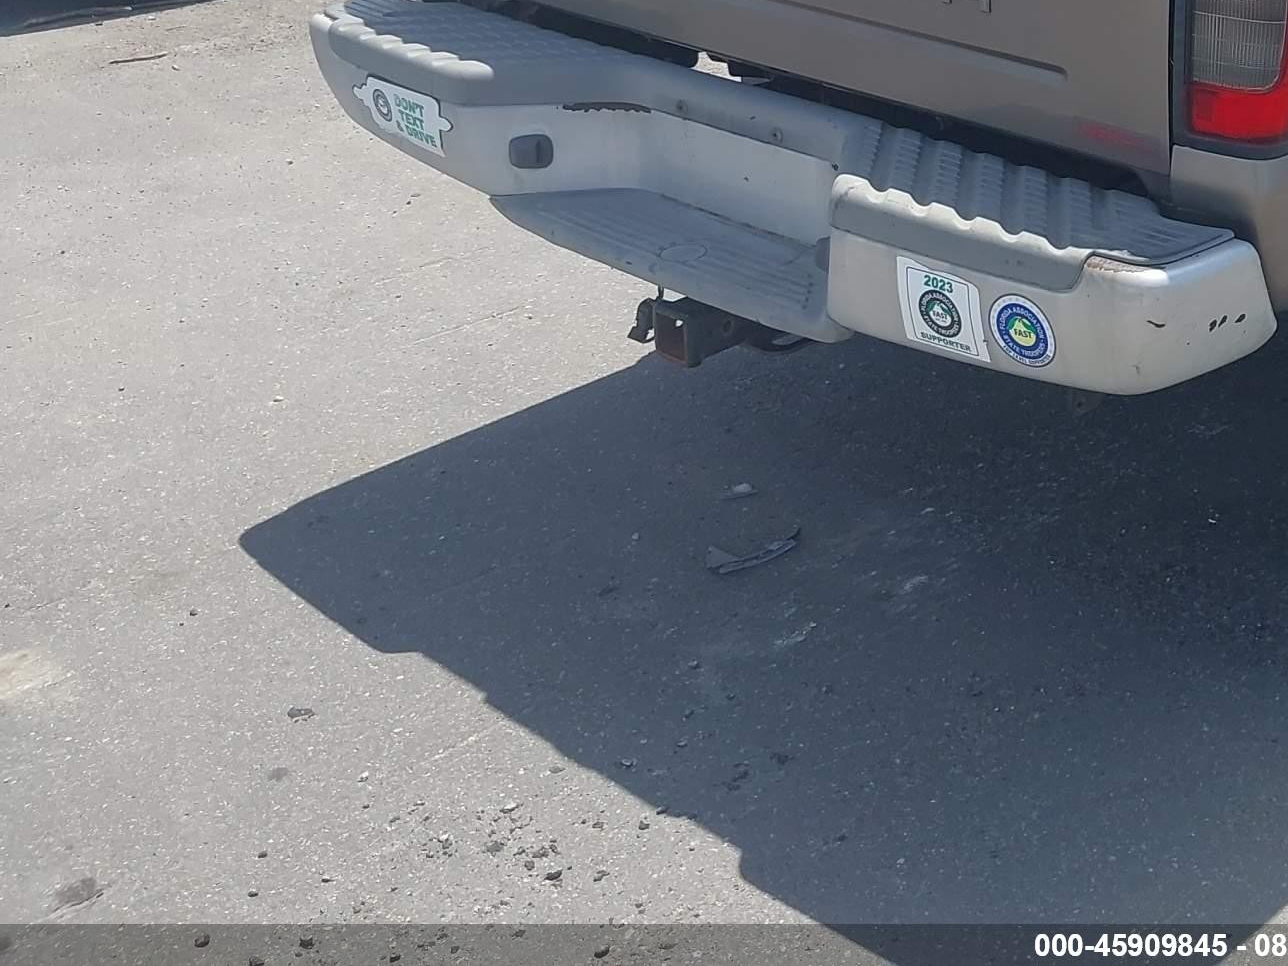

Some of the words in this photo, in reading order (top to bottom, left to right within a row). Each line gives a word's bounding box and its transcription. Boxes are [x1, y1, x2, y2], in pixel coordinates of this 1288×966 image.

[394, 94, 424, 117] DON'T
[398, 109, 424, 131] TEXT
[404, 124, 437, 148] DRIVE
[924, 274, 953, 294] 2023
[932, 310, 948, 320] FAST
[1012, 306, 1045, 339] ASSOCIATION
[921, 332, 972, 352] SUPPORTER
[1014, 328, 1032, 339] FAST
